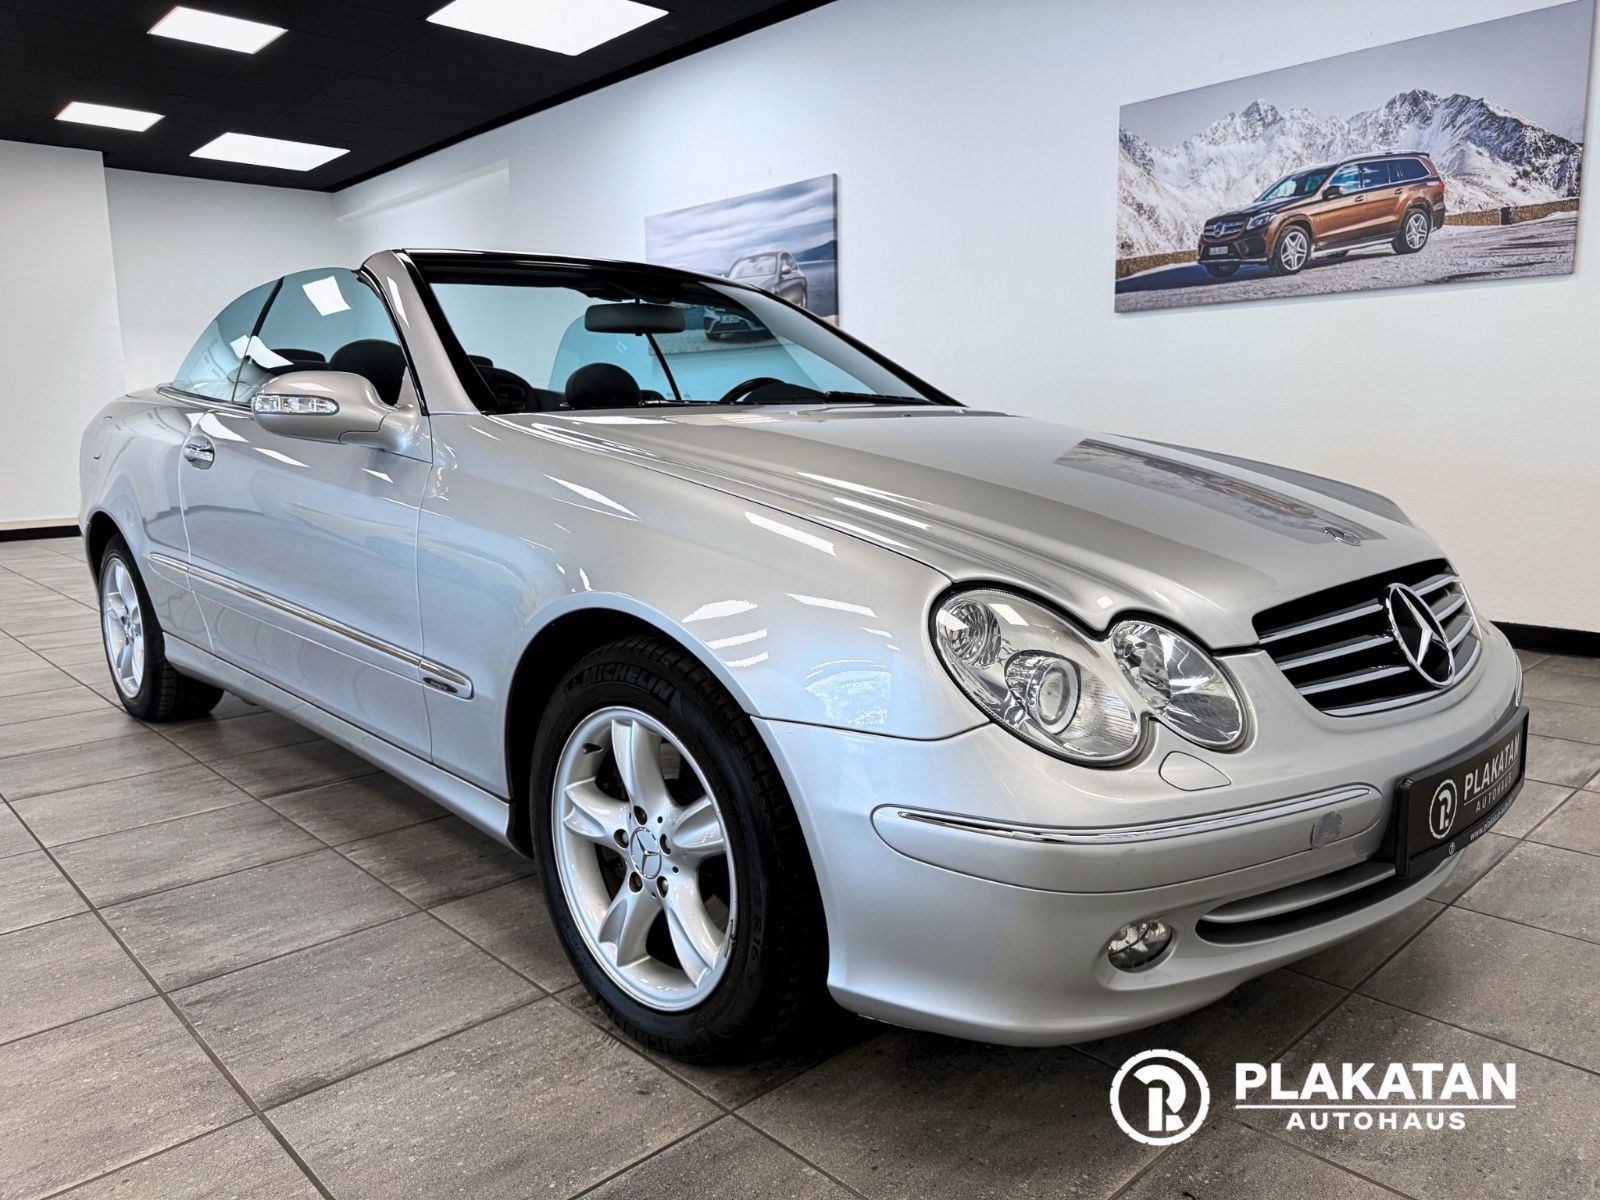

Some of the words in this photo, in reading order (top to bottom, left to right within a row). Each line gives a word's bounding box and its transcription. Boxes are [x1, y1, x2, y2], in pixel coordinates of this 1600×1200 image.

[582, 663, 675, 702] MICHELIN
[1464, 732, 1521, 800] PLAKATAN
[1475, 771, 1513, 813] AUTOHAUS
